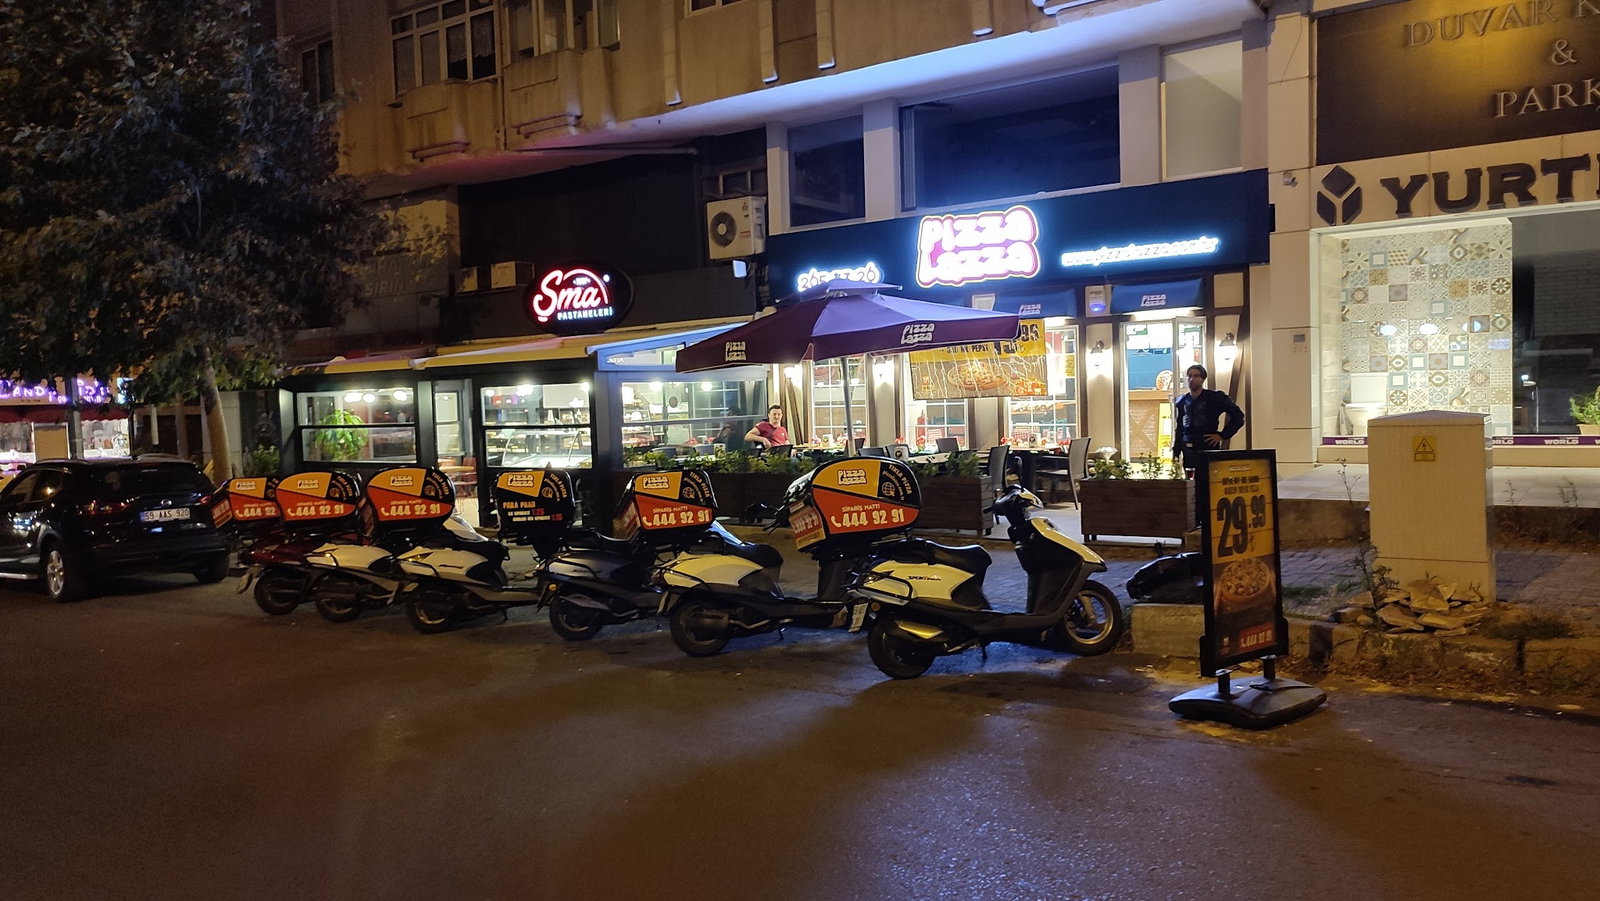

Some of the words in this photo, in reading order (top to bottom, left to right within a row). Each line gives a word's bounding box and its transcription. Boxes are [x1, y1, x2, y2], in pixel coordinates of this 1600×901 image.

[1406, 0, 1558, 47] DUVAR
[1551, 39, 1577, 65] &
[557, 306, 614, 320] PASTANELERİ
[145, 511, 154, 520] 59
[158, 511, 172, 519] AAS
[176, 508, 189, 517] 920
[295, 505, 316, 516] 444
[319, 504, 331, 515] 92
[334, 504, 344, 514] 91
[390, 505, 411, 516] 444
[414, 504, 427, 515] 92
[430, 503, 441, 514] 91
[842, 512, 869, 527] 444
[872, 510, 888, 524] 92
[891, 508, 905, 523] 91
[652, 512, 677, 527] 444
[680, 511, 694, 524] 92
[697, 509, 710, 523] 91
